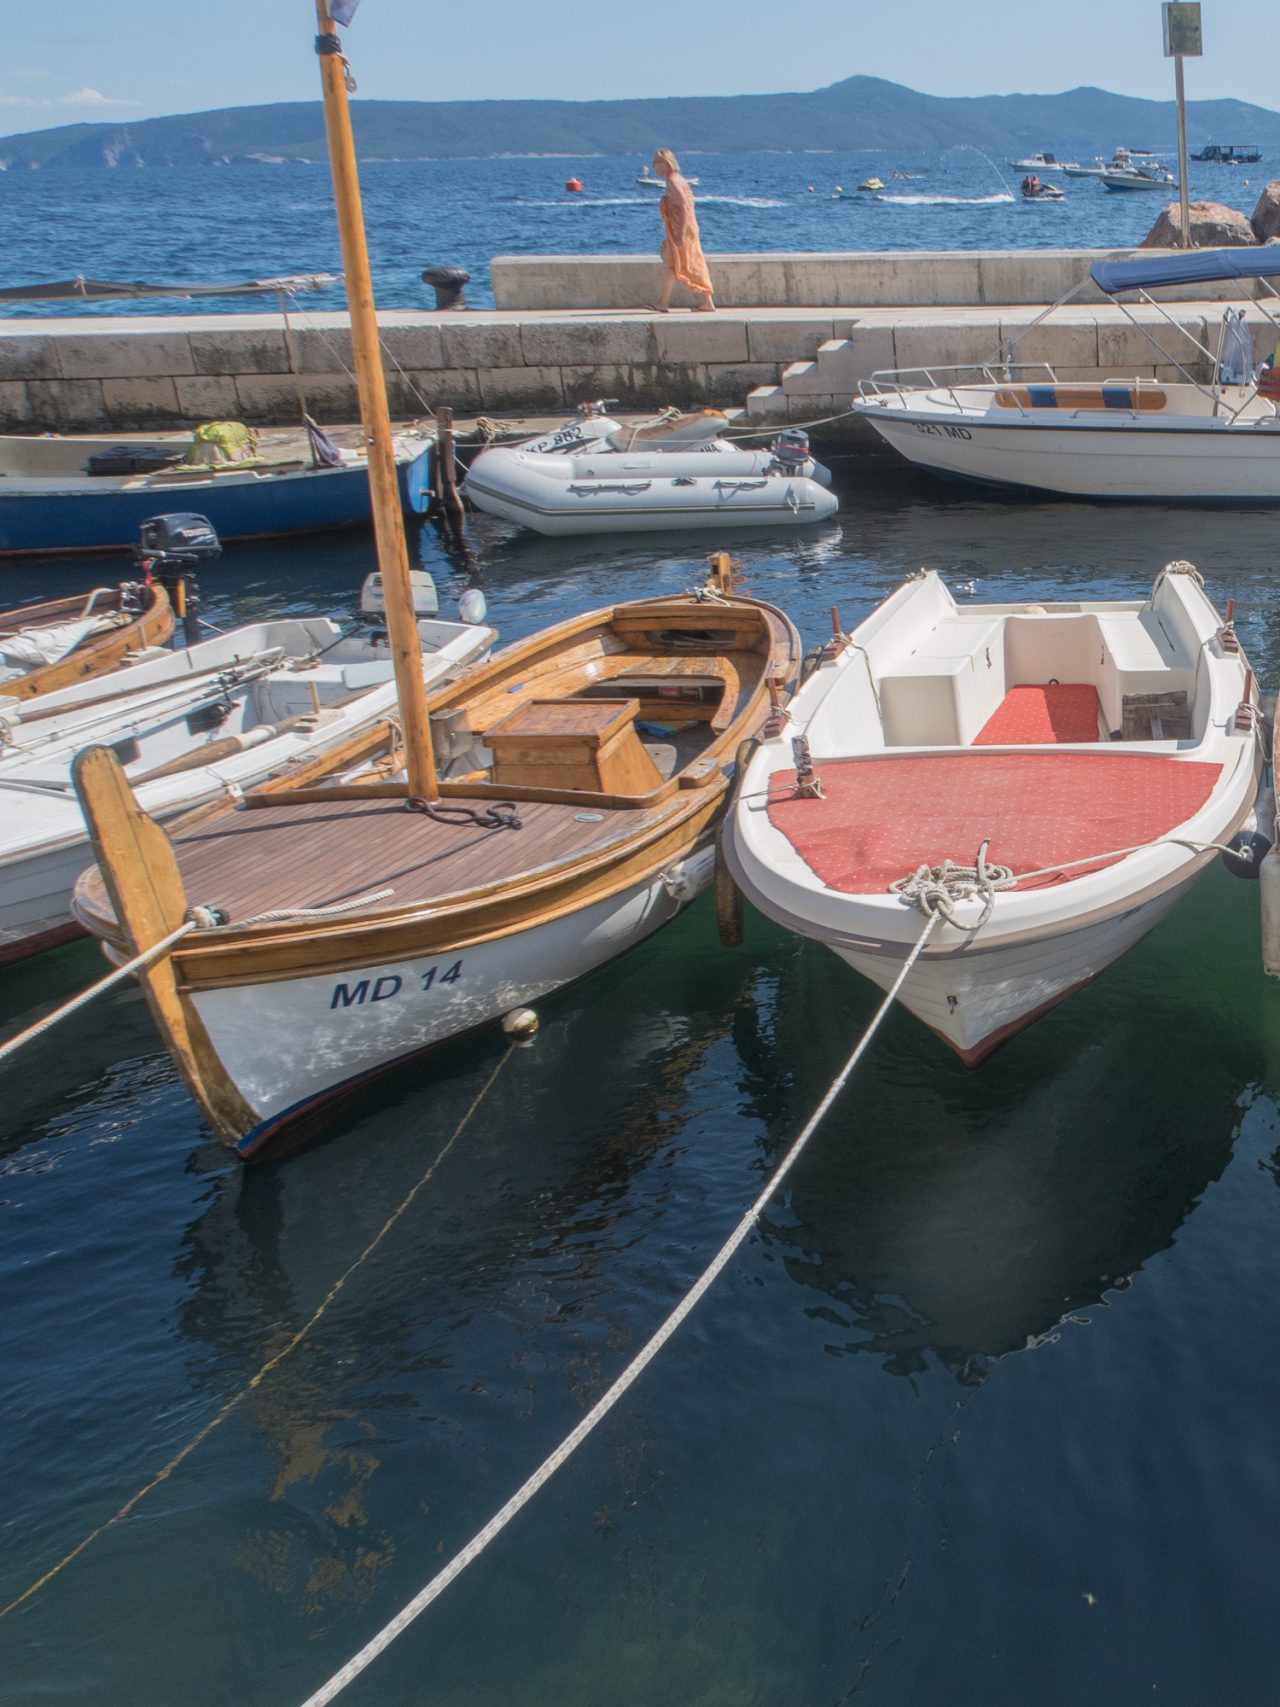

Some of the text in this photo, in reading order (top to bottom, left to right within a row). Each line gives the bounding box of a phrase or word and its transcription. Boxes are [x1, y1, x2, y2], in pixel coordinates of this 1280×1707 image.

[943, 425, 972, 441] MD
[330, 959, 464, 1010] MD 14
